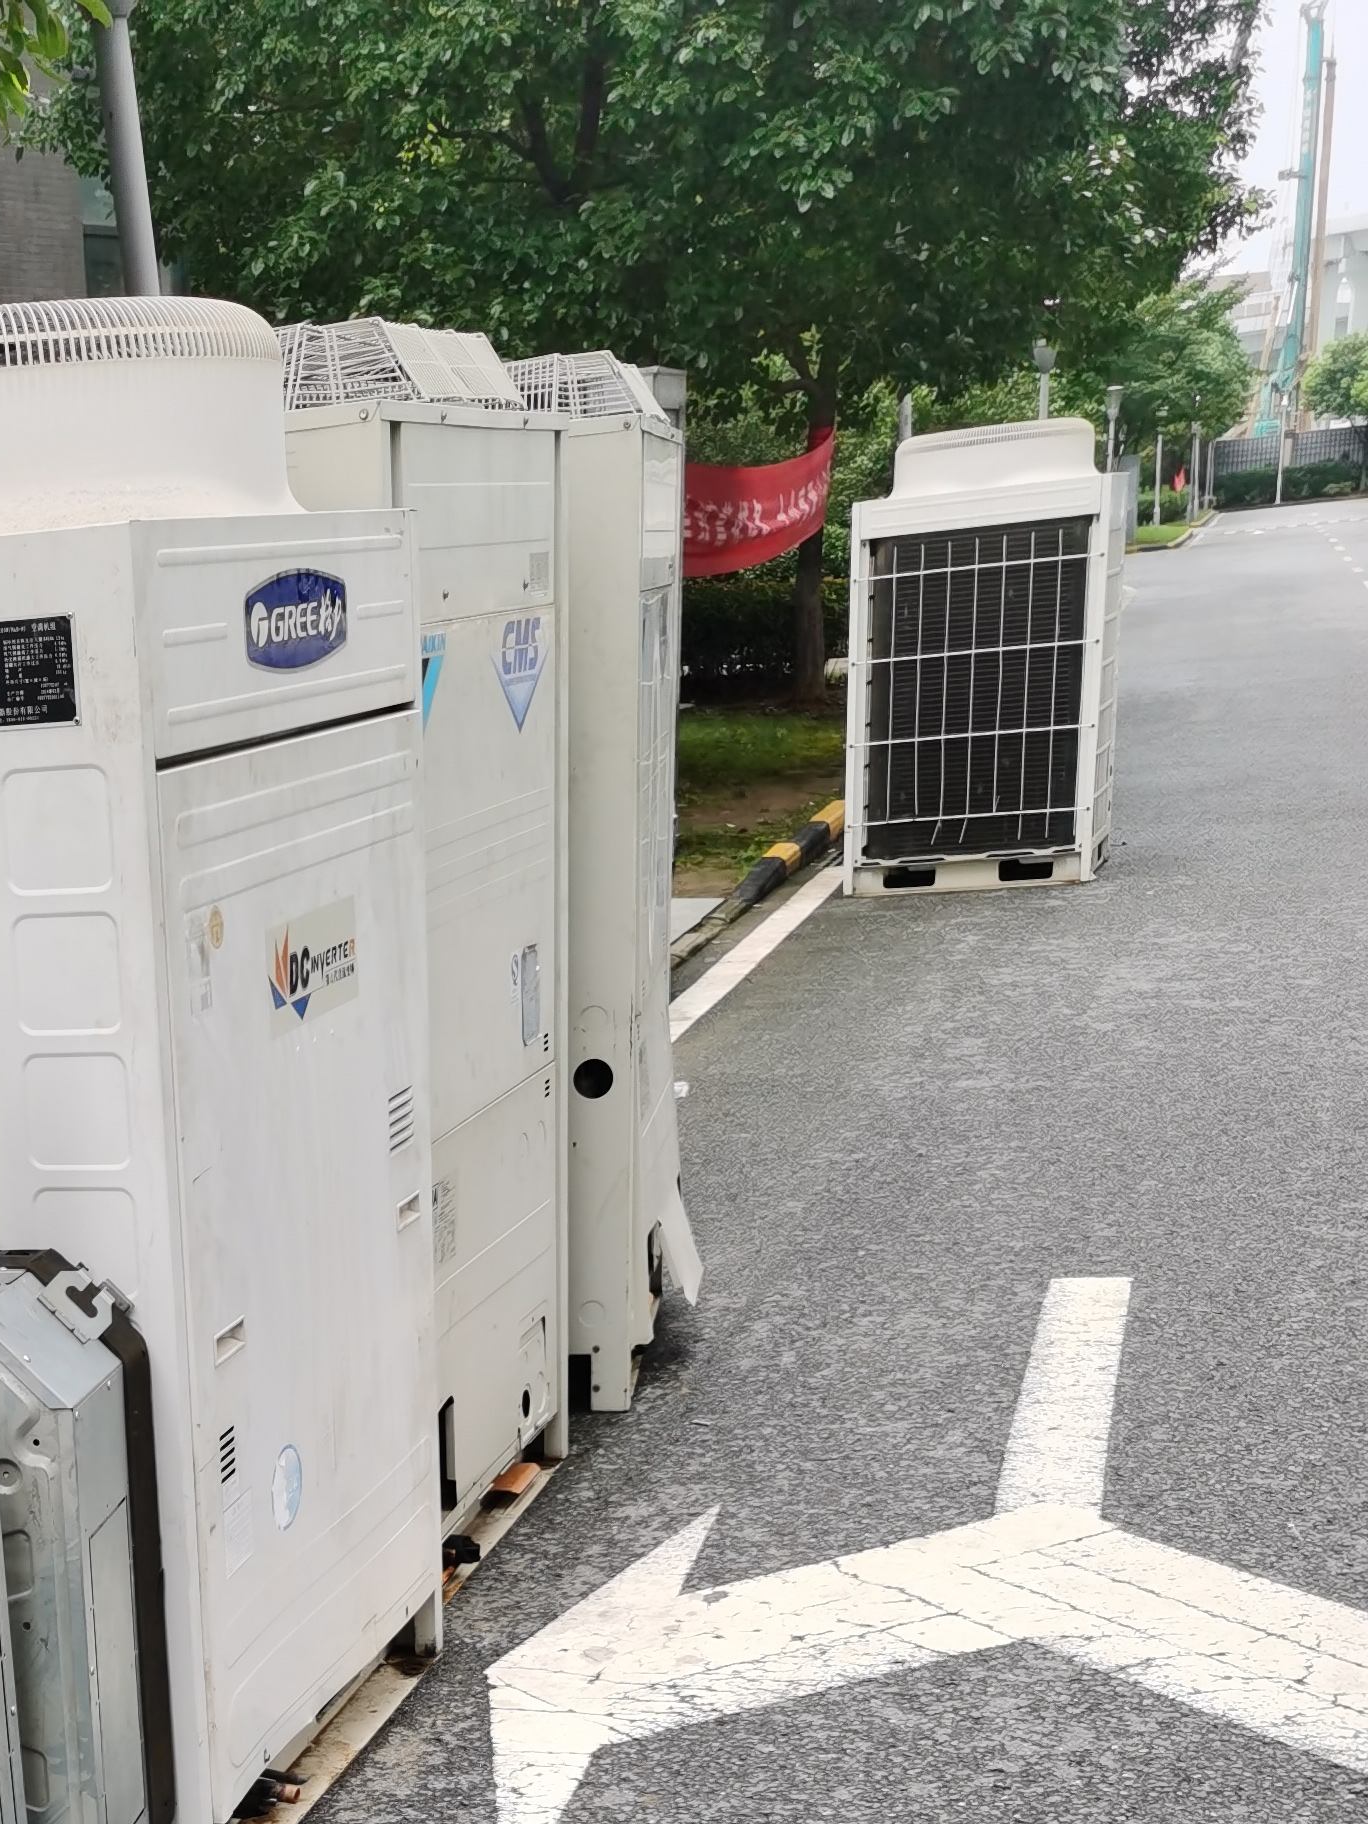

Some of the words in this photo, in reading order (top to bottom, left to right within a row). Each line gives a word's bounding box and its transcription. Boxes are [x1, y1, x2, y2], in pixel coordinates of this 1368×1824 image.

[271, 602, 318, 643] GREE
[421, 632, 446, 656] AIKIN
[501, 617, 541, 675] CMS
[289, 945, 310, 997] DC
